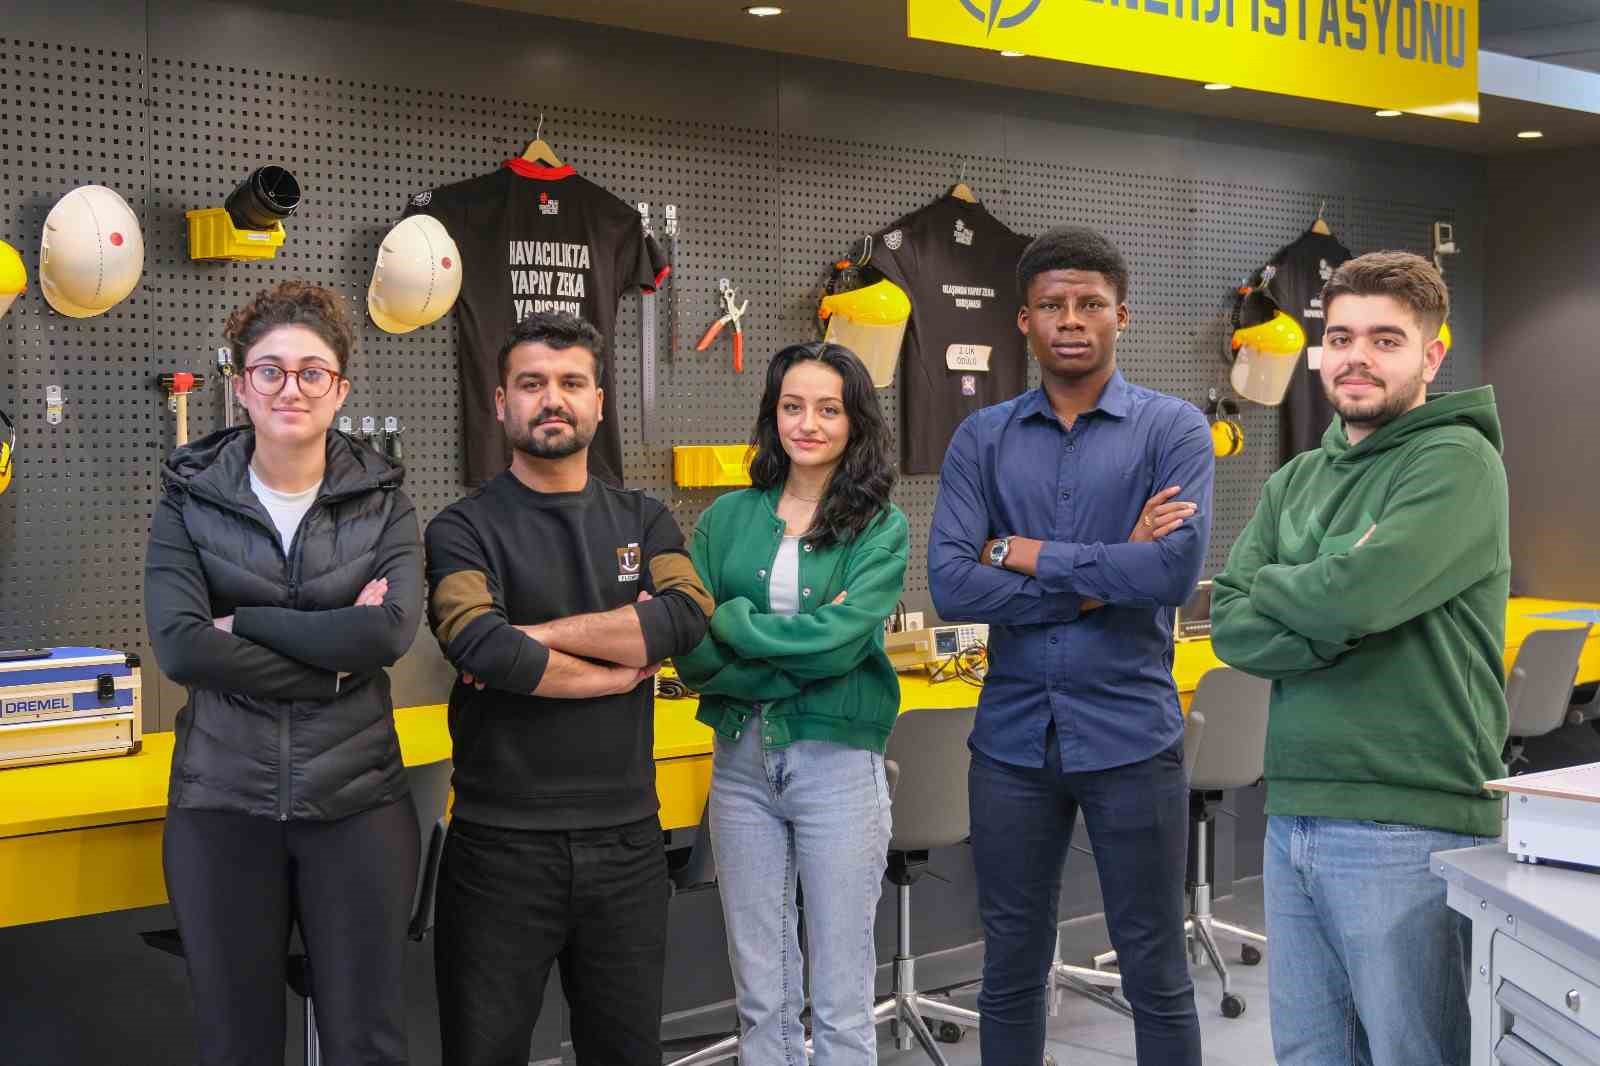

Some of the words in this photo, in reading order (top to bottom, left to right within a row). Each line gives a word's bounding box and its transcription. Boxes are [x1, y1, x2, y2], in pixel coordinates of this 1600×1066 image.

[509, 240, 590, 270] HAVACILIKTA
[511, 270, 553, 295] YAPAY
[556, 271, 585, 298] ZEKA
[5, 697, 70, 714] DREMEL
